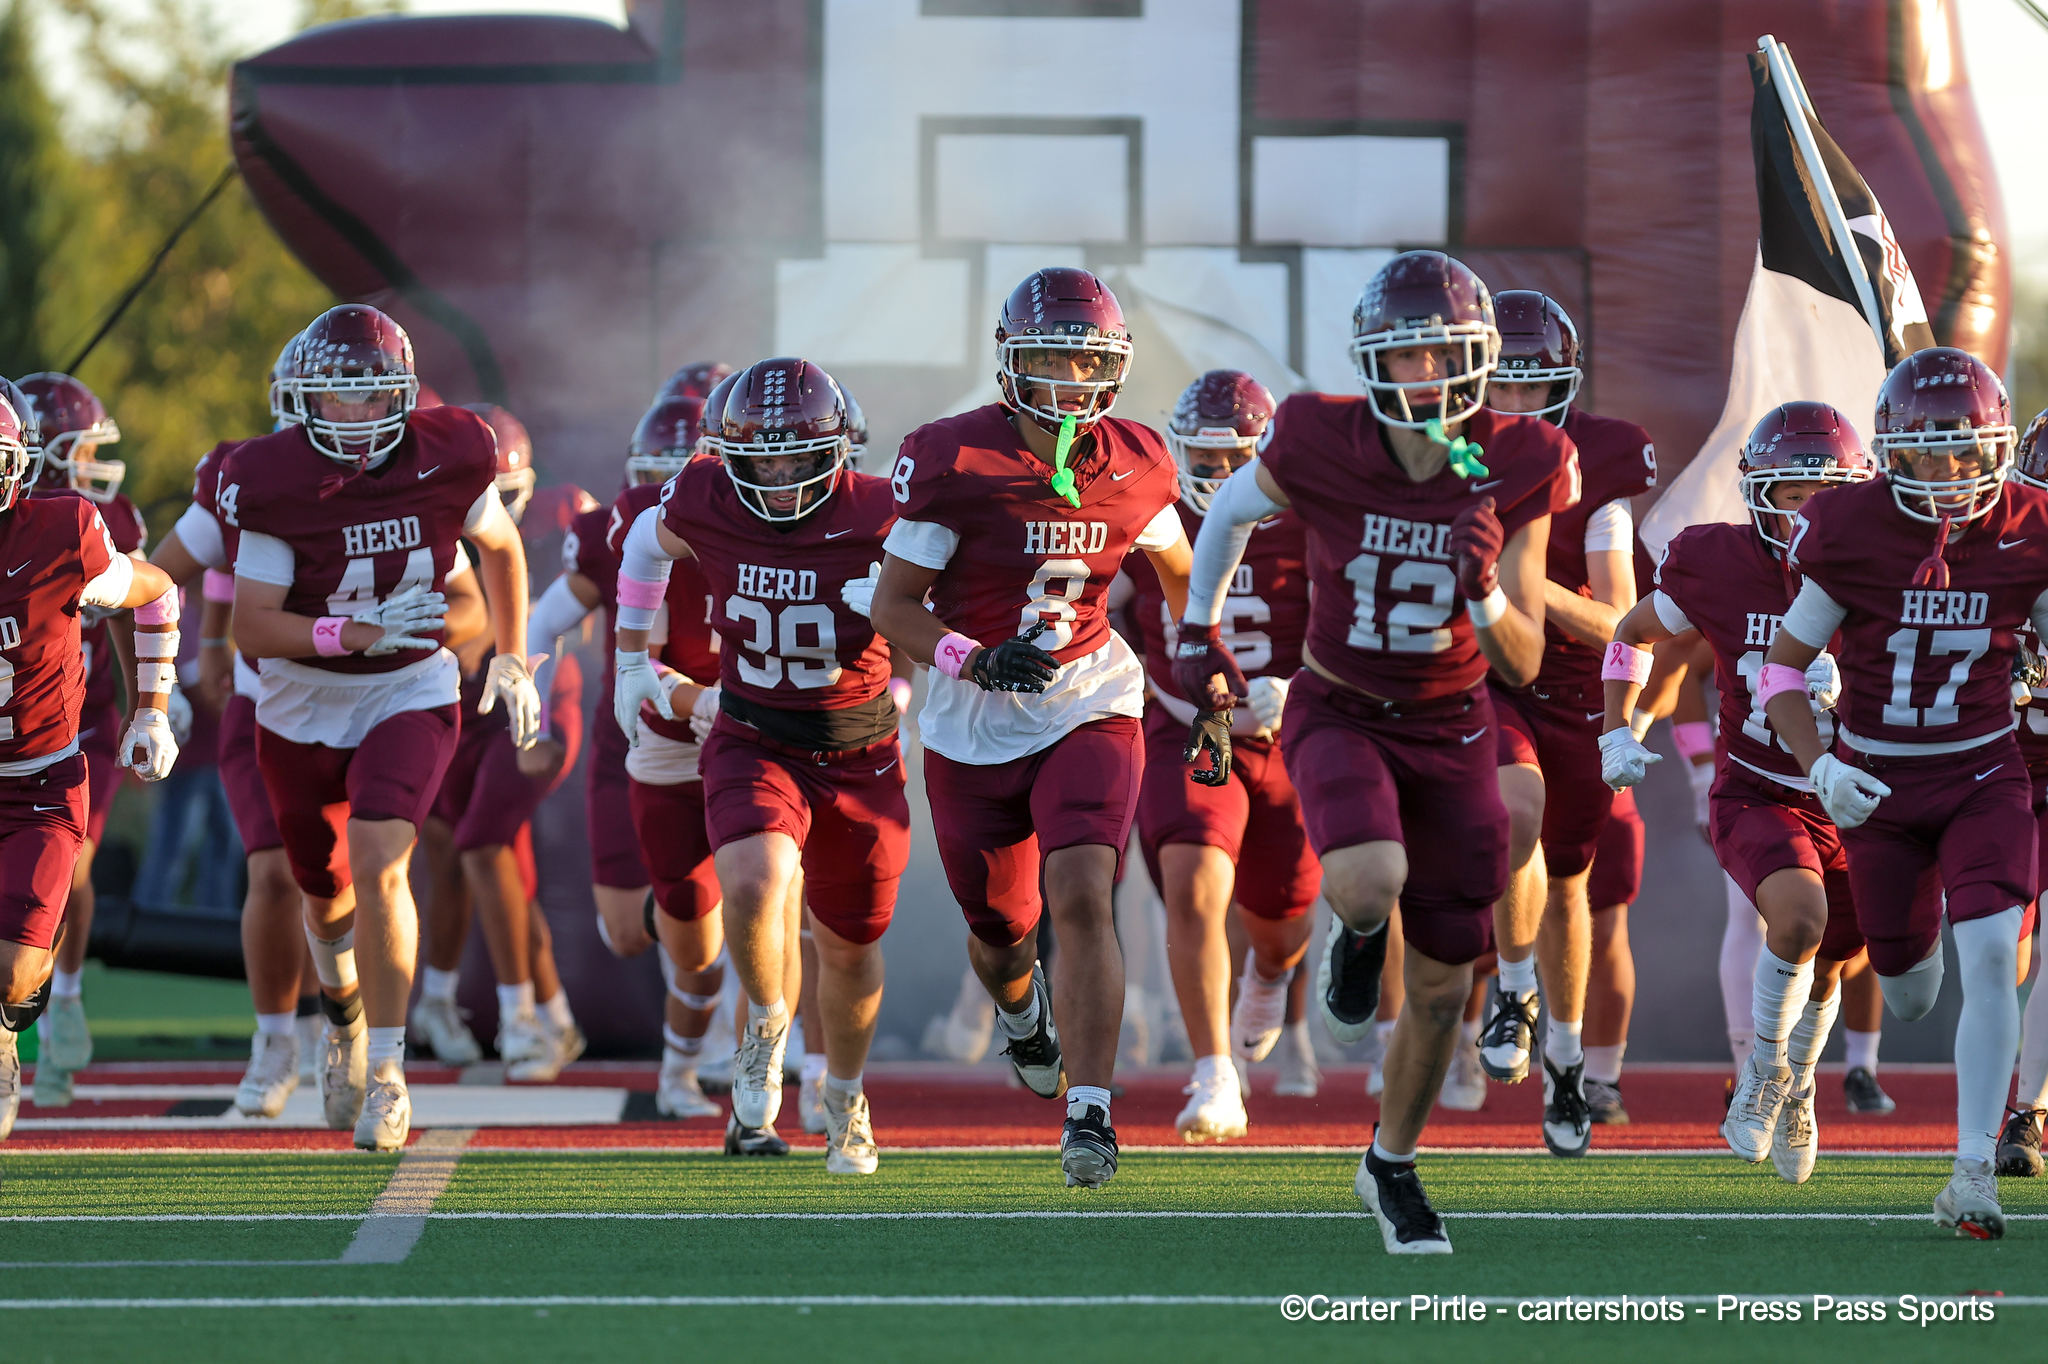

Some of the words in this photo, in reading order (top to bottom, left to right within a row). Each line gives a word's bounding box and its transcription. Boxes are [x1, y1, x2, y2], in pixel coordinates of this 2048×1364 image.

[1070, 324, 1083, 333] F7
[1512, 360, 1525, 368] F7
[768, 433, 781, 441] F7
[890, 455, 916, 504] 8
[1642, 443, 1658, 487] 9
[1807, 457, 1820, 465] F7
[342, 515, 422, 557] HERD
[1023, 521, 1108, 554] HERD
[737, 562, 818, 601] HERD
[1344, 552, 1457, 653] 12
[1017, 558, 1092, 651] 8
[1900, 590, 1990, 625] HERD
[725, 594, 843, 690] 39
[1160, 595, 1273, 672] 6
[1882, 627, 1992, 727] 17
